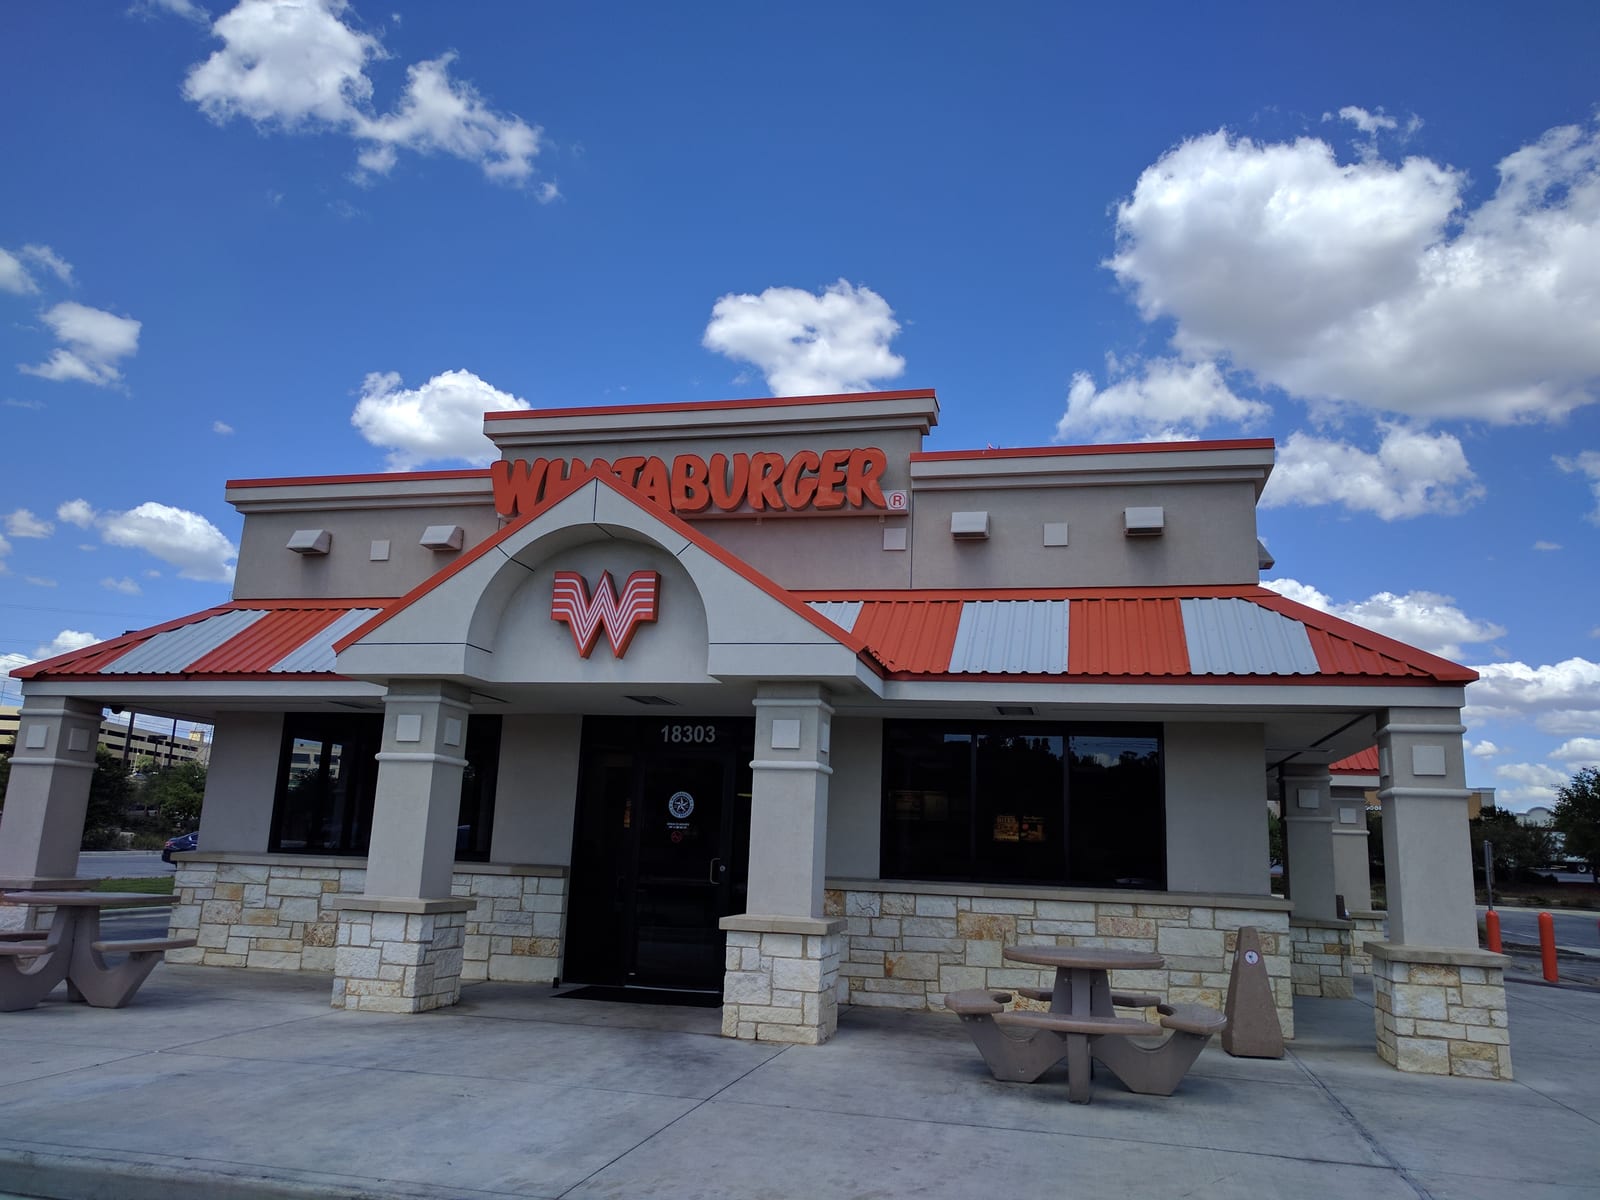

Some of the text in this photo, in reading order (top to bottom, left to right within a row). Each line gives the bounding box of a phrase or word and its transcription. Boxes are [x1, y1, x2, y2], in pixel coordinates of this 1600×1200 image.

[491, 447, 888, 515] WHTABURGER
[551, 569, 661, 658] W
[660, 724, 717, 743] 18303
